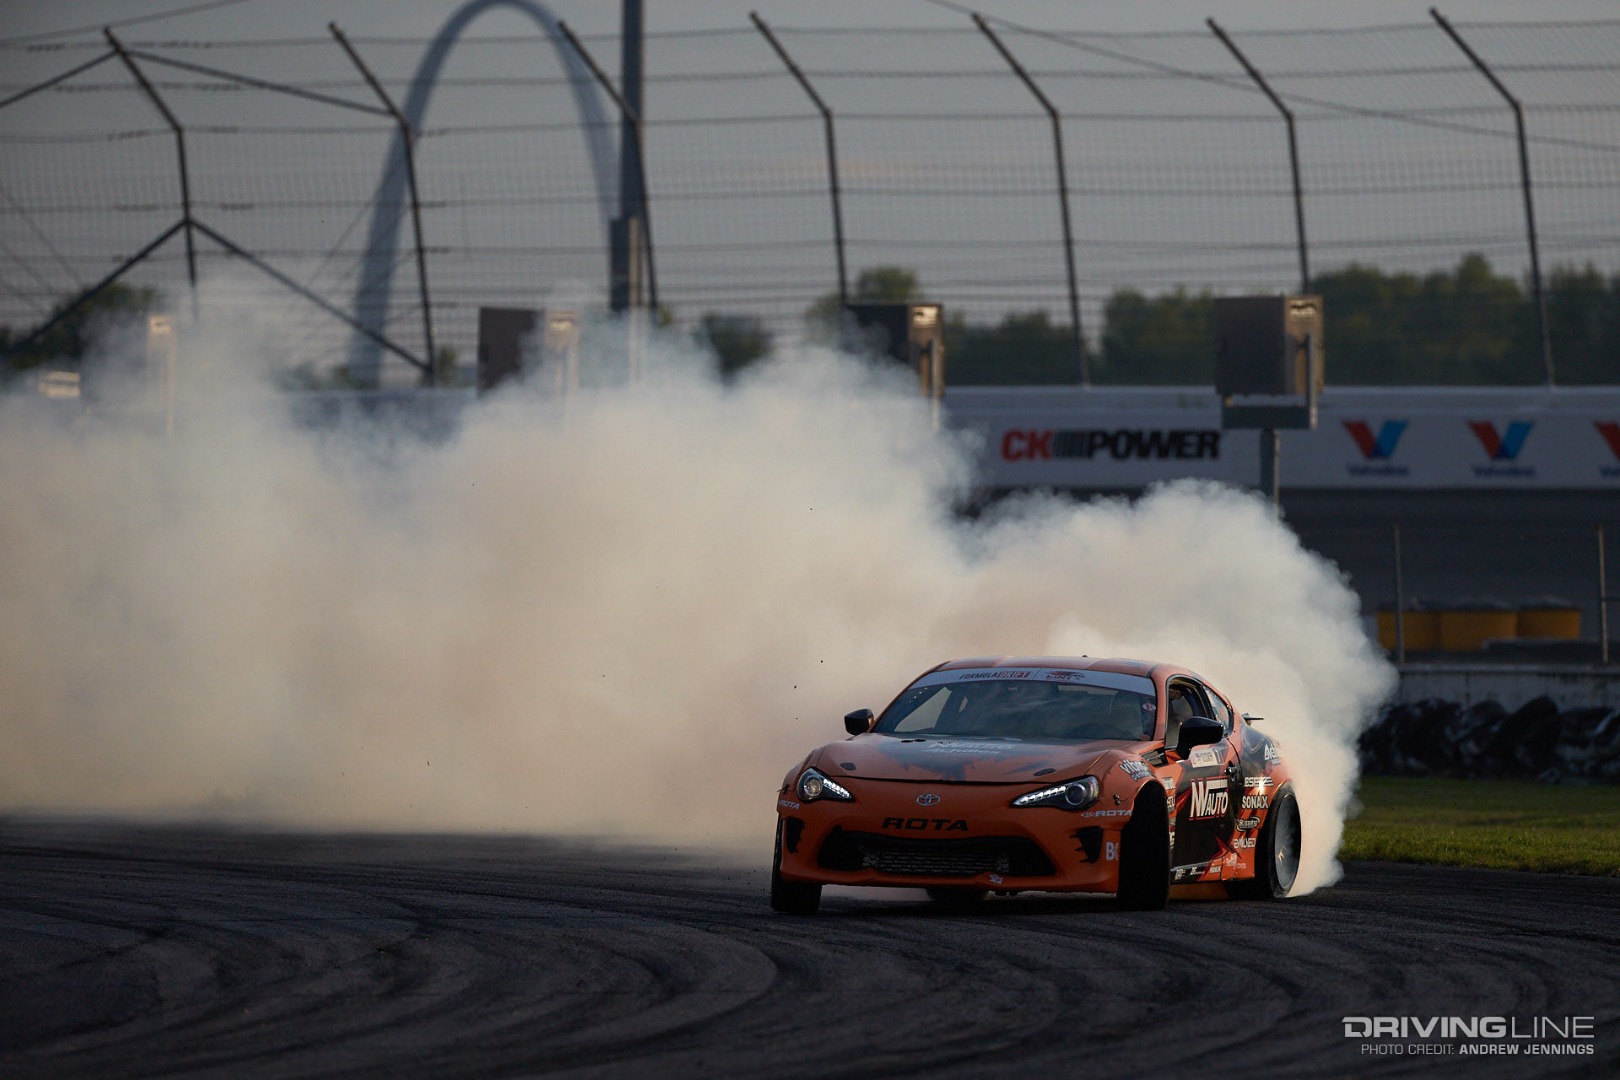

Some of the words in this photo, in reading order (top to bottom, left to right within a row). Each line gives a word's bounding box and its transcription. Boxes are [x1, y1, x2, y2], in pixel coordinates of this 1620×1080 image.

[1087, 430, 1219, 459] POWER
[1241, 794, 1269, 810] SONAX
[881, 817, 969, 832] ROTA
